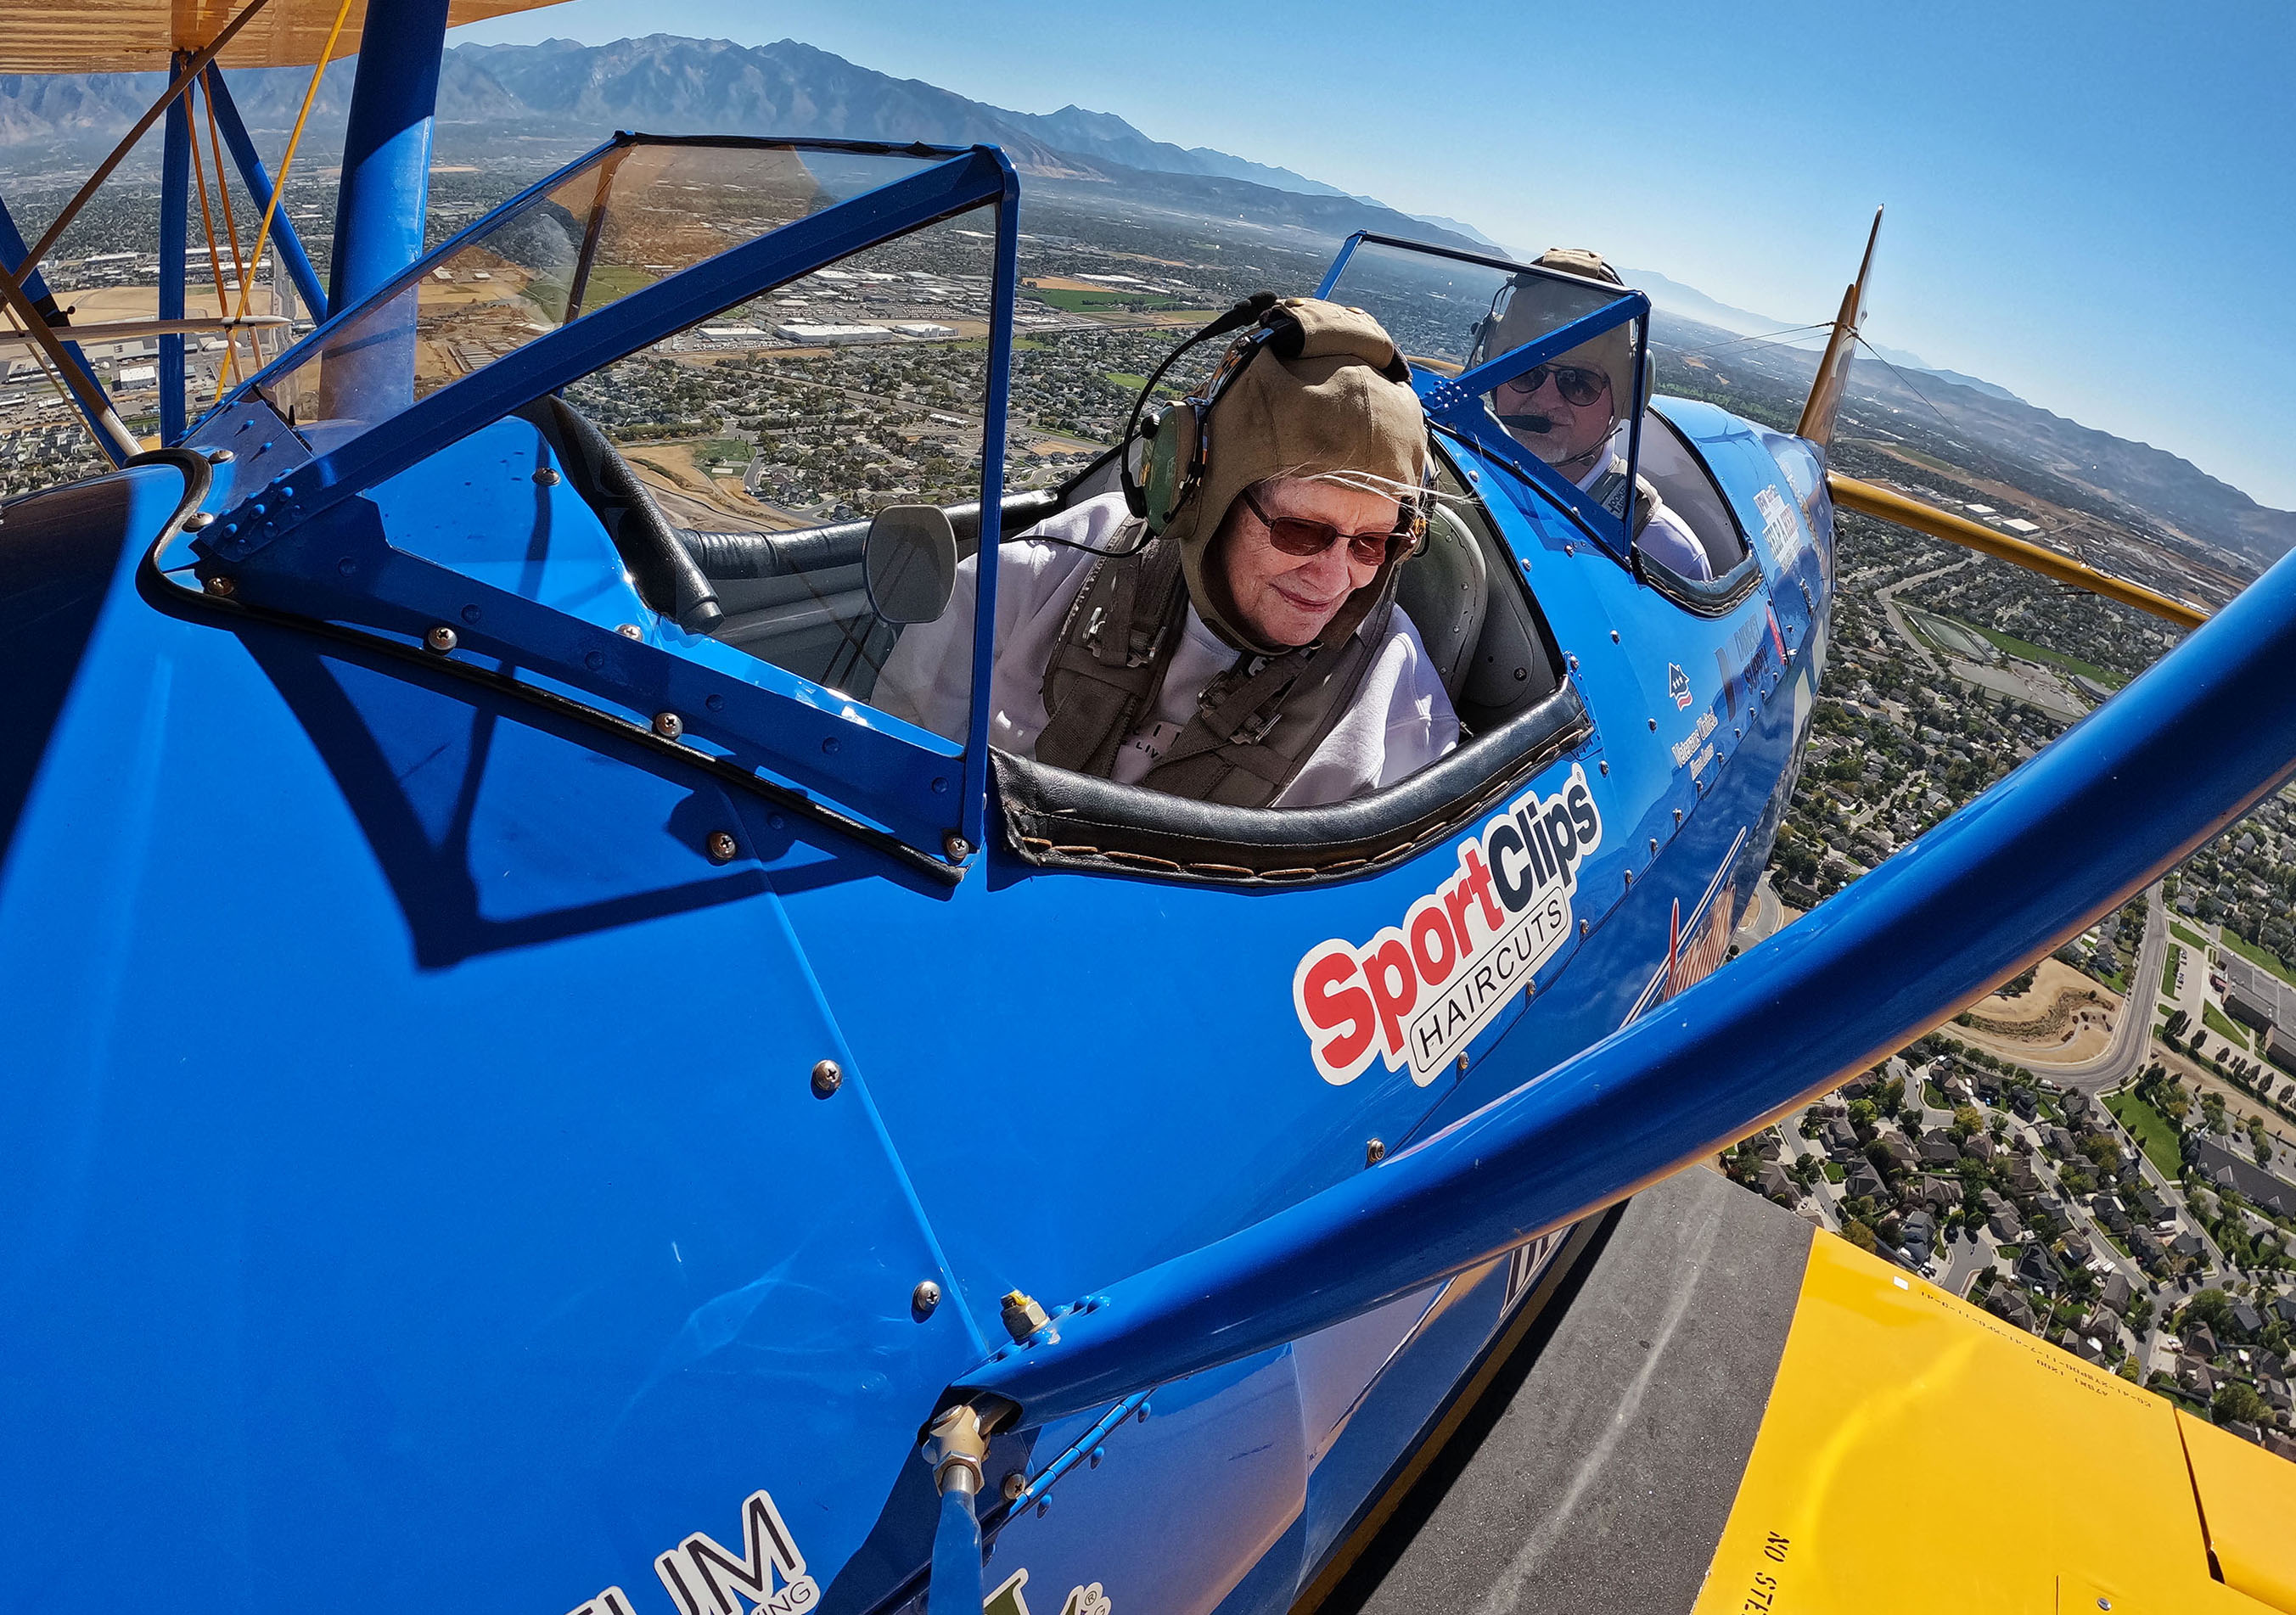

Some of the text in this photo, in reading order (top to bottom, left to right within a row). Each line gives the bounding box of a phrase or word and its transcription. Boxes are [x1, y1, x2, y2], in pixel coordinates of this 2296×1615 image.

[1671, 728, 1702, 769] Veterans
[1418, 897, 1563, 1059] HAIRCUTS
[1742, 1531, 1790, 1615] NO STE
